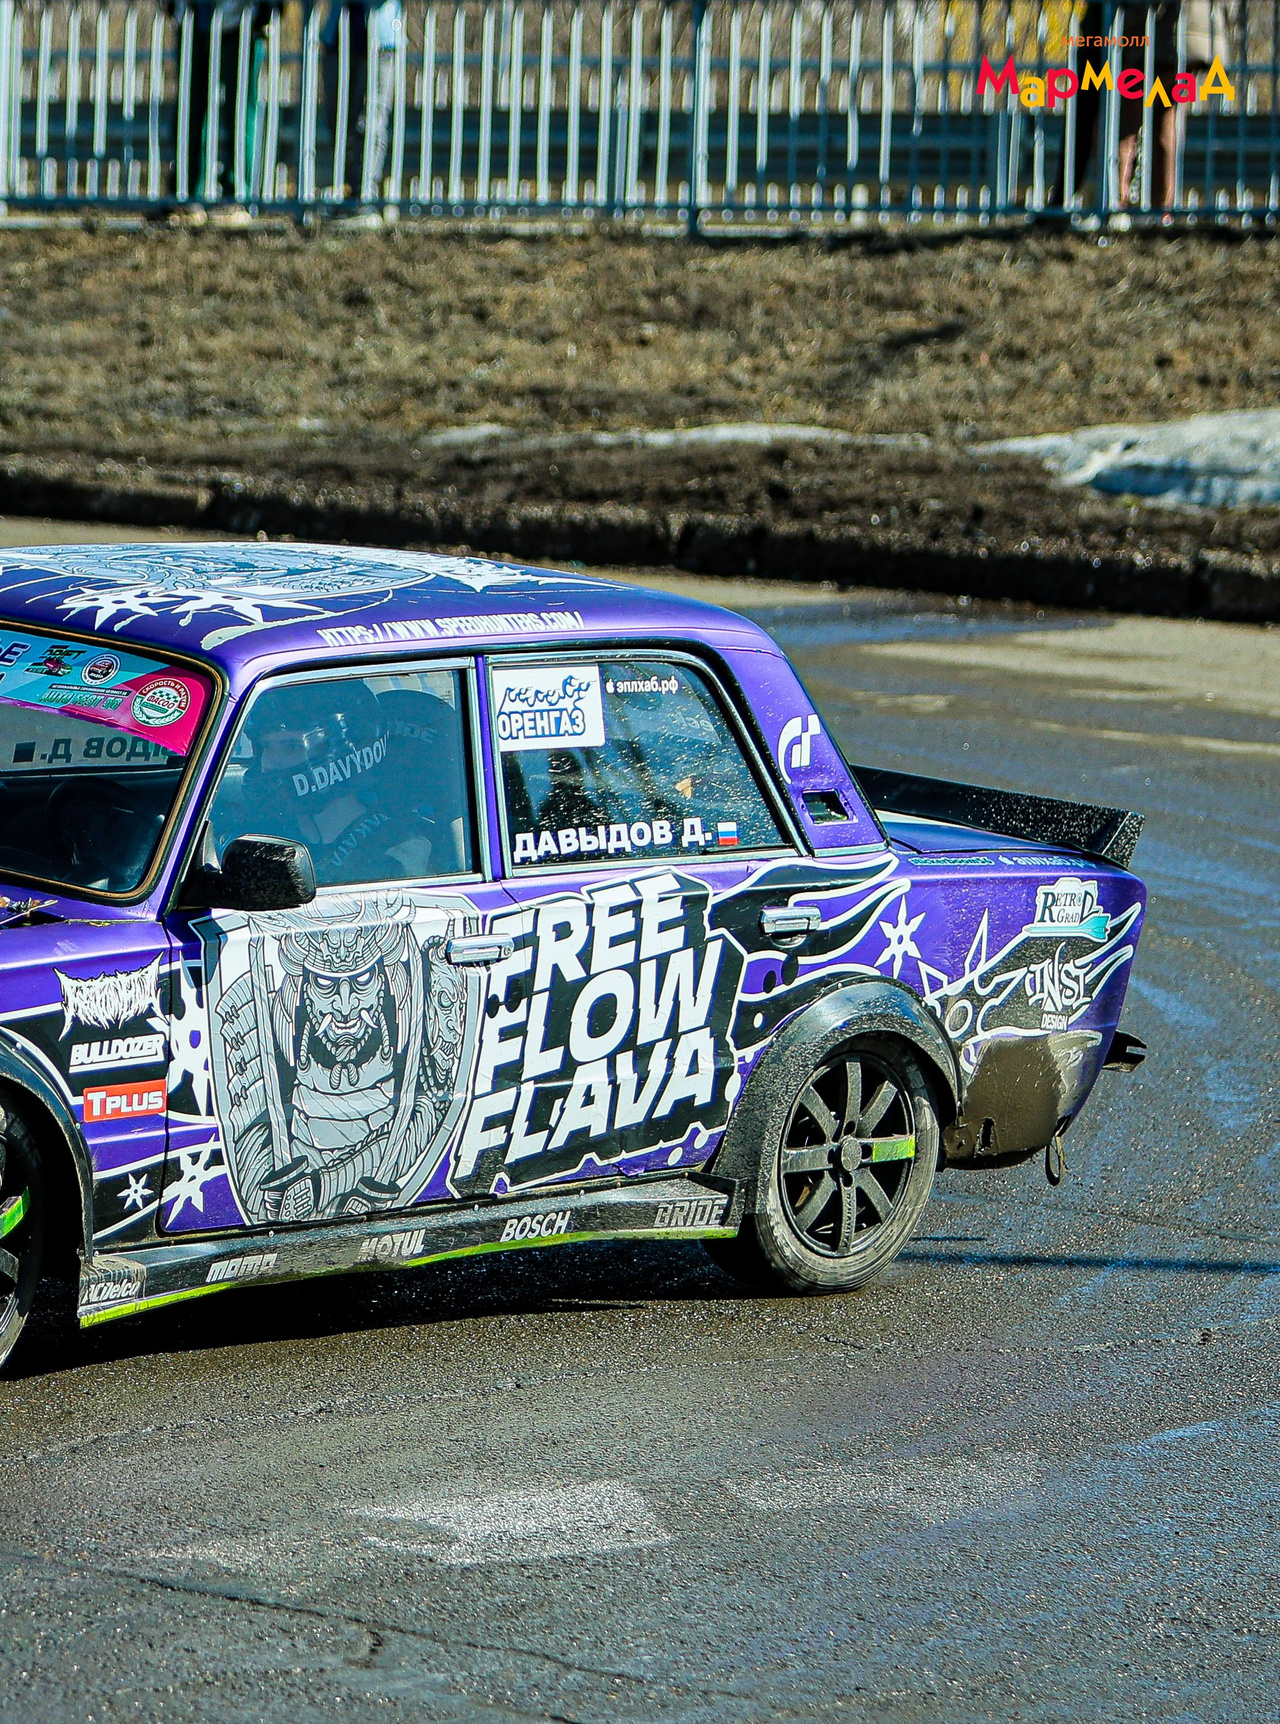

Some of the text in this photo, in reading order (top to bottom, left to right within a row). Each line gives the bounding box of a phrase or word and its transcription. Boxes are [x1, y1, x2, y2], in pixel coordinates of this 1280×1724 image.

[317, 611, 585, 647] HTTPS://WWW.SPEEDHUNTERS.COM/
[142, 681, 175, 694] СКОРОСТЬ
[616, 676, 679, 695] эплхаб.рф
[497, 708, 586, 740] ОРЕНГАЗ
[513, 817, 713, 863] ДАВЫДОВ Д.
[488, 873, 686, 1001] FREE
[474, 938, 723, 1097] FLOW
[1041, 1014, 1068, 1031] DESIGN
[70, 1034, 164, 1067] BULLDOZER
[87, 1091, 163, 1116] TPLUS
[454, 1027, 715, 1179] FLAVA
[500, 1211, 571, 1242] BOSCH
[653, 1199, 726, 1228] BRIDE
[358, 1229, 426, 1262] MOTUL
